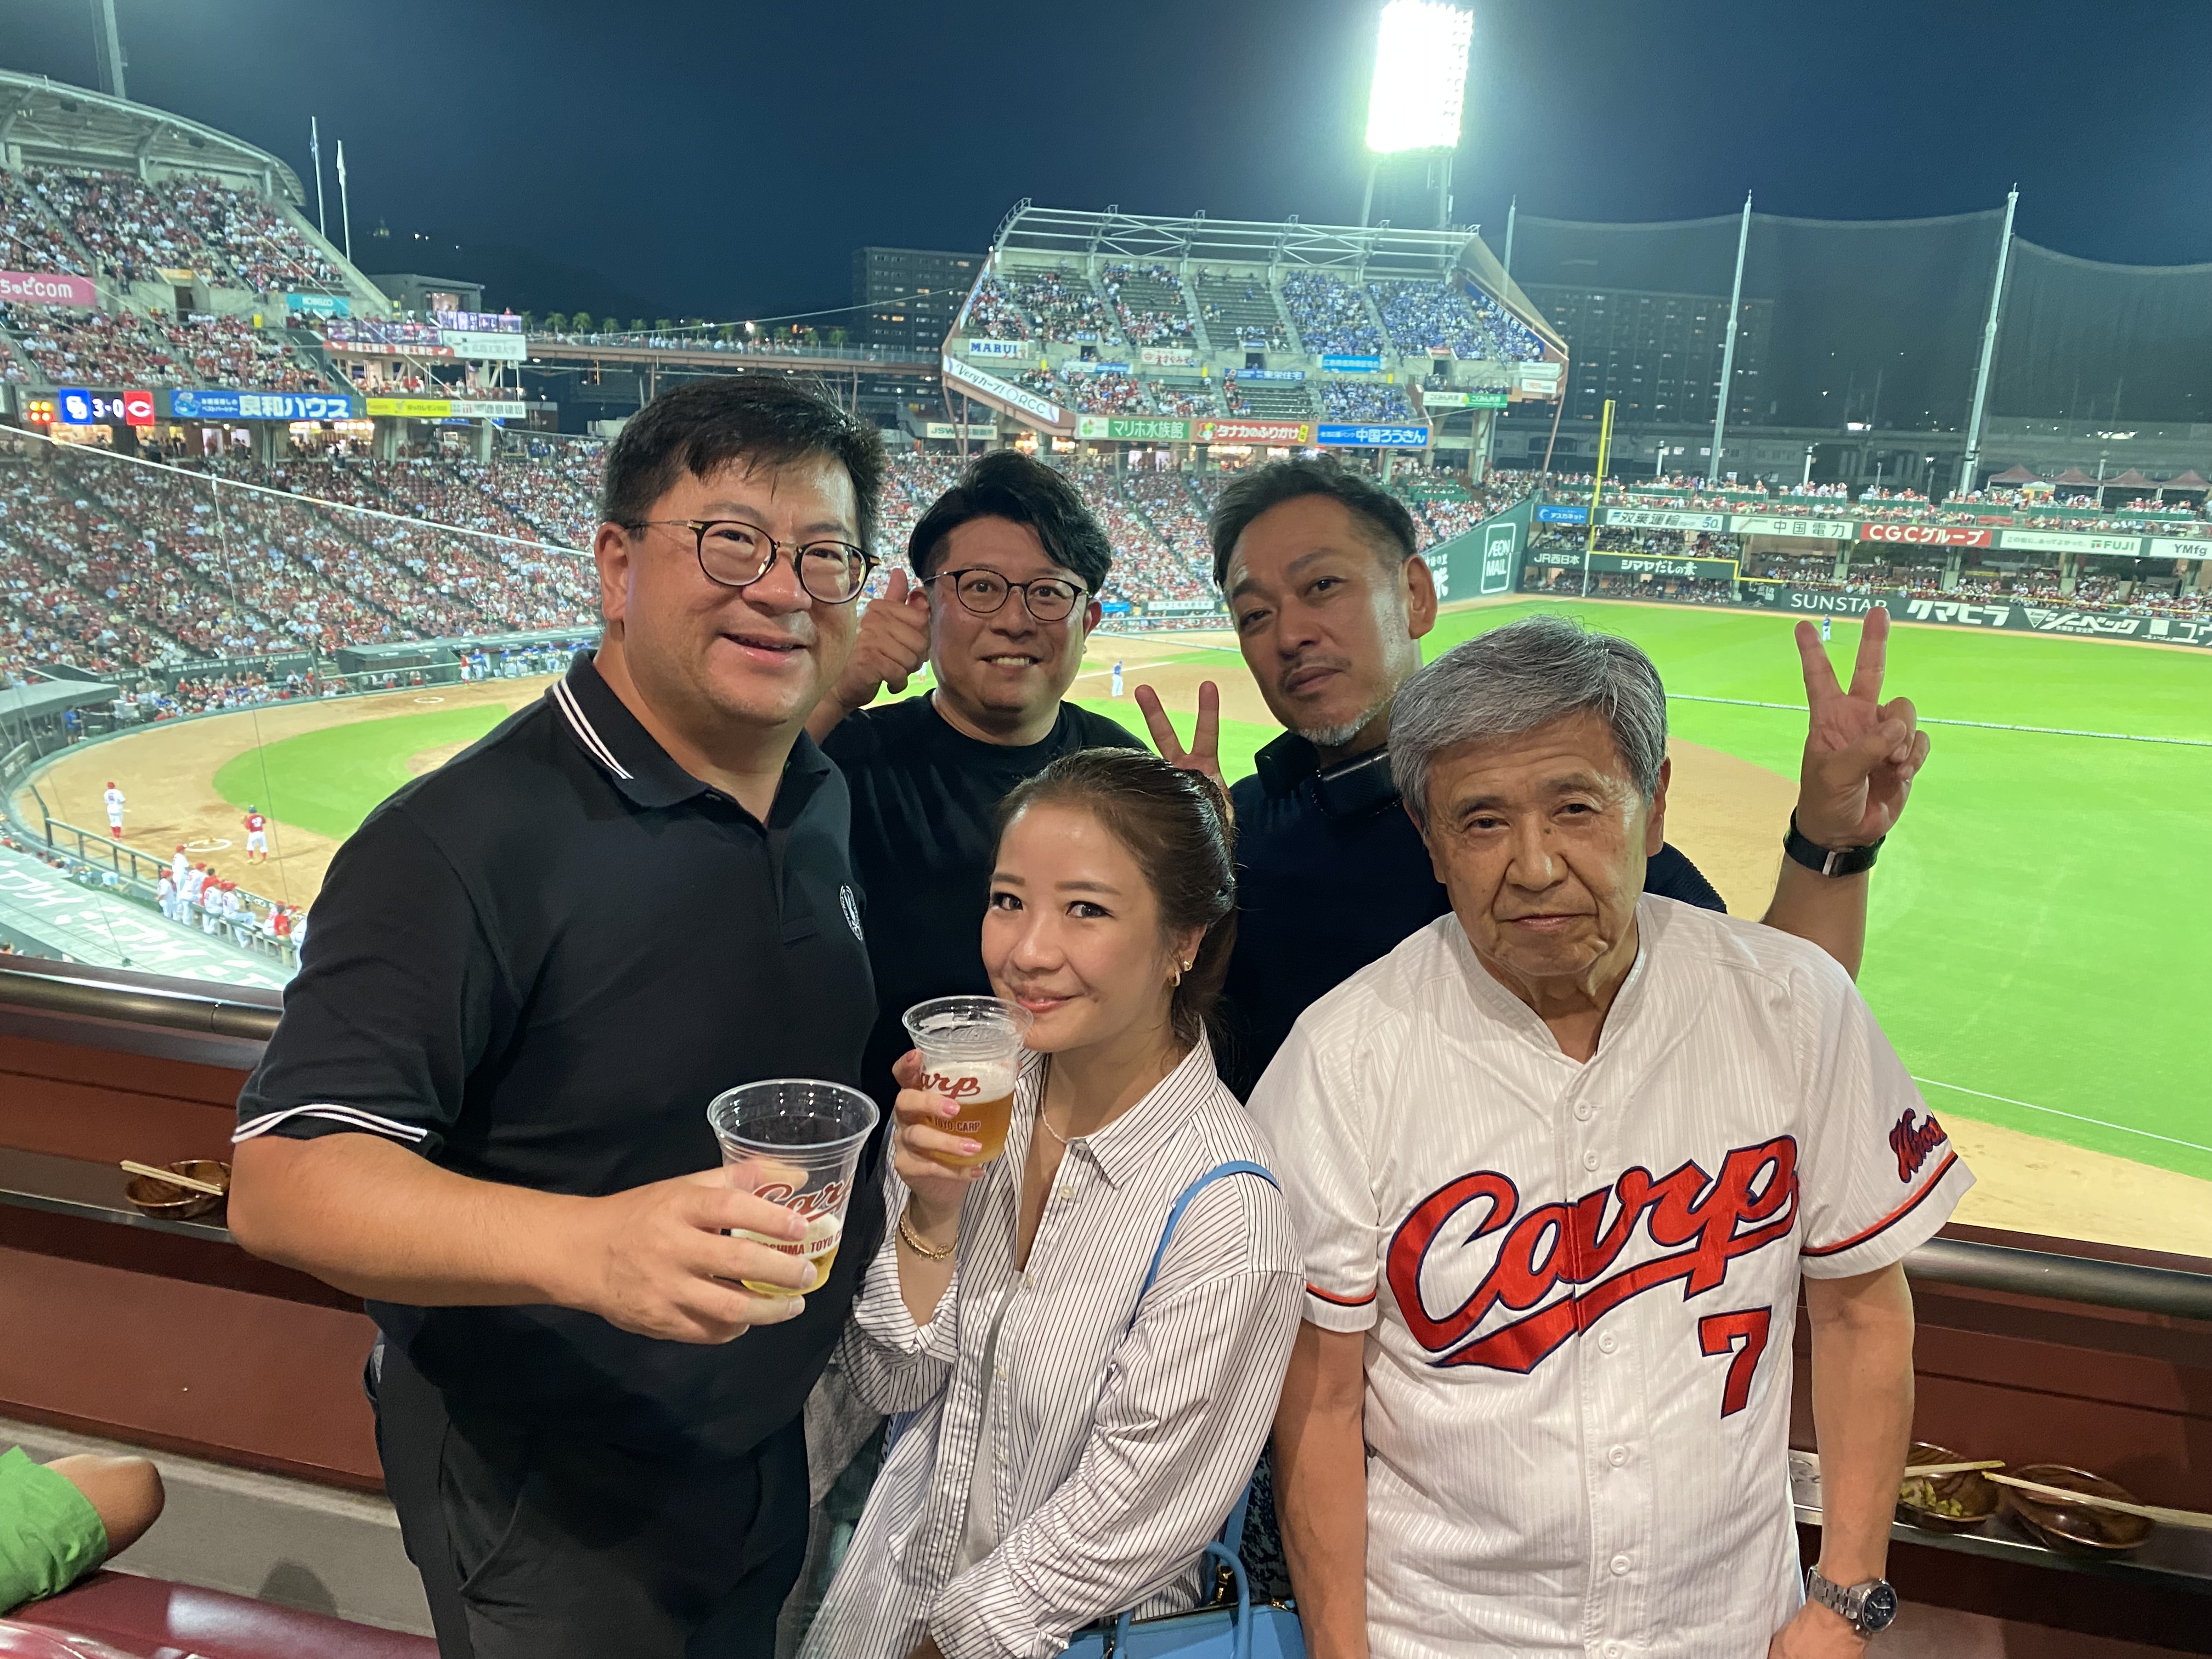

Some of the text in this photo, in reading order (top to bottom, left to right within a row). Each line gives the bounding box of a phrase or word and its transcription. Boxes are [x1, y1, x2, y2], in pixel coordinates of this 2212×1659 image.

[970, 342, 1017, 354] MARUI
[239, 394, 349, 417] 良和ハウス
[1019, 394, 1046, 414] RCC
[1113, 420, 1184, 439] マリホ水族館
[1217, 425, 1300, 439] タナカのふりかけ
[1356, 428, 1426, 444] 中国ろうきん
[1550, 512, 1585, 521] アスカネット
[1621, 511, 1681, 526] 双葉運輸
[1774, 520, 1845, 537] 中国電力
[1870, 524, 1984, 545] CGCグループ
[2103, 540, 2134, 551] FUJI
[2174, 544, 2208, 557] YMfg
[1534, 552, 1580, 565] JR西日本
[1486, 558, 1507, 577] MALL
[1621, 559, 1697, 576] シマヤだしの素
[1906, 599, 2010, 627] クマヒラ
[2039, 612, 2141, 635] ジーベック
[957, 1122, 980, 1131] CARP
[810, 1235, 833, 1253] TOYO
[1387, 1135, 1799, 1374] Carp
[1698, 1306, 1772, 1419] 7
